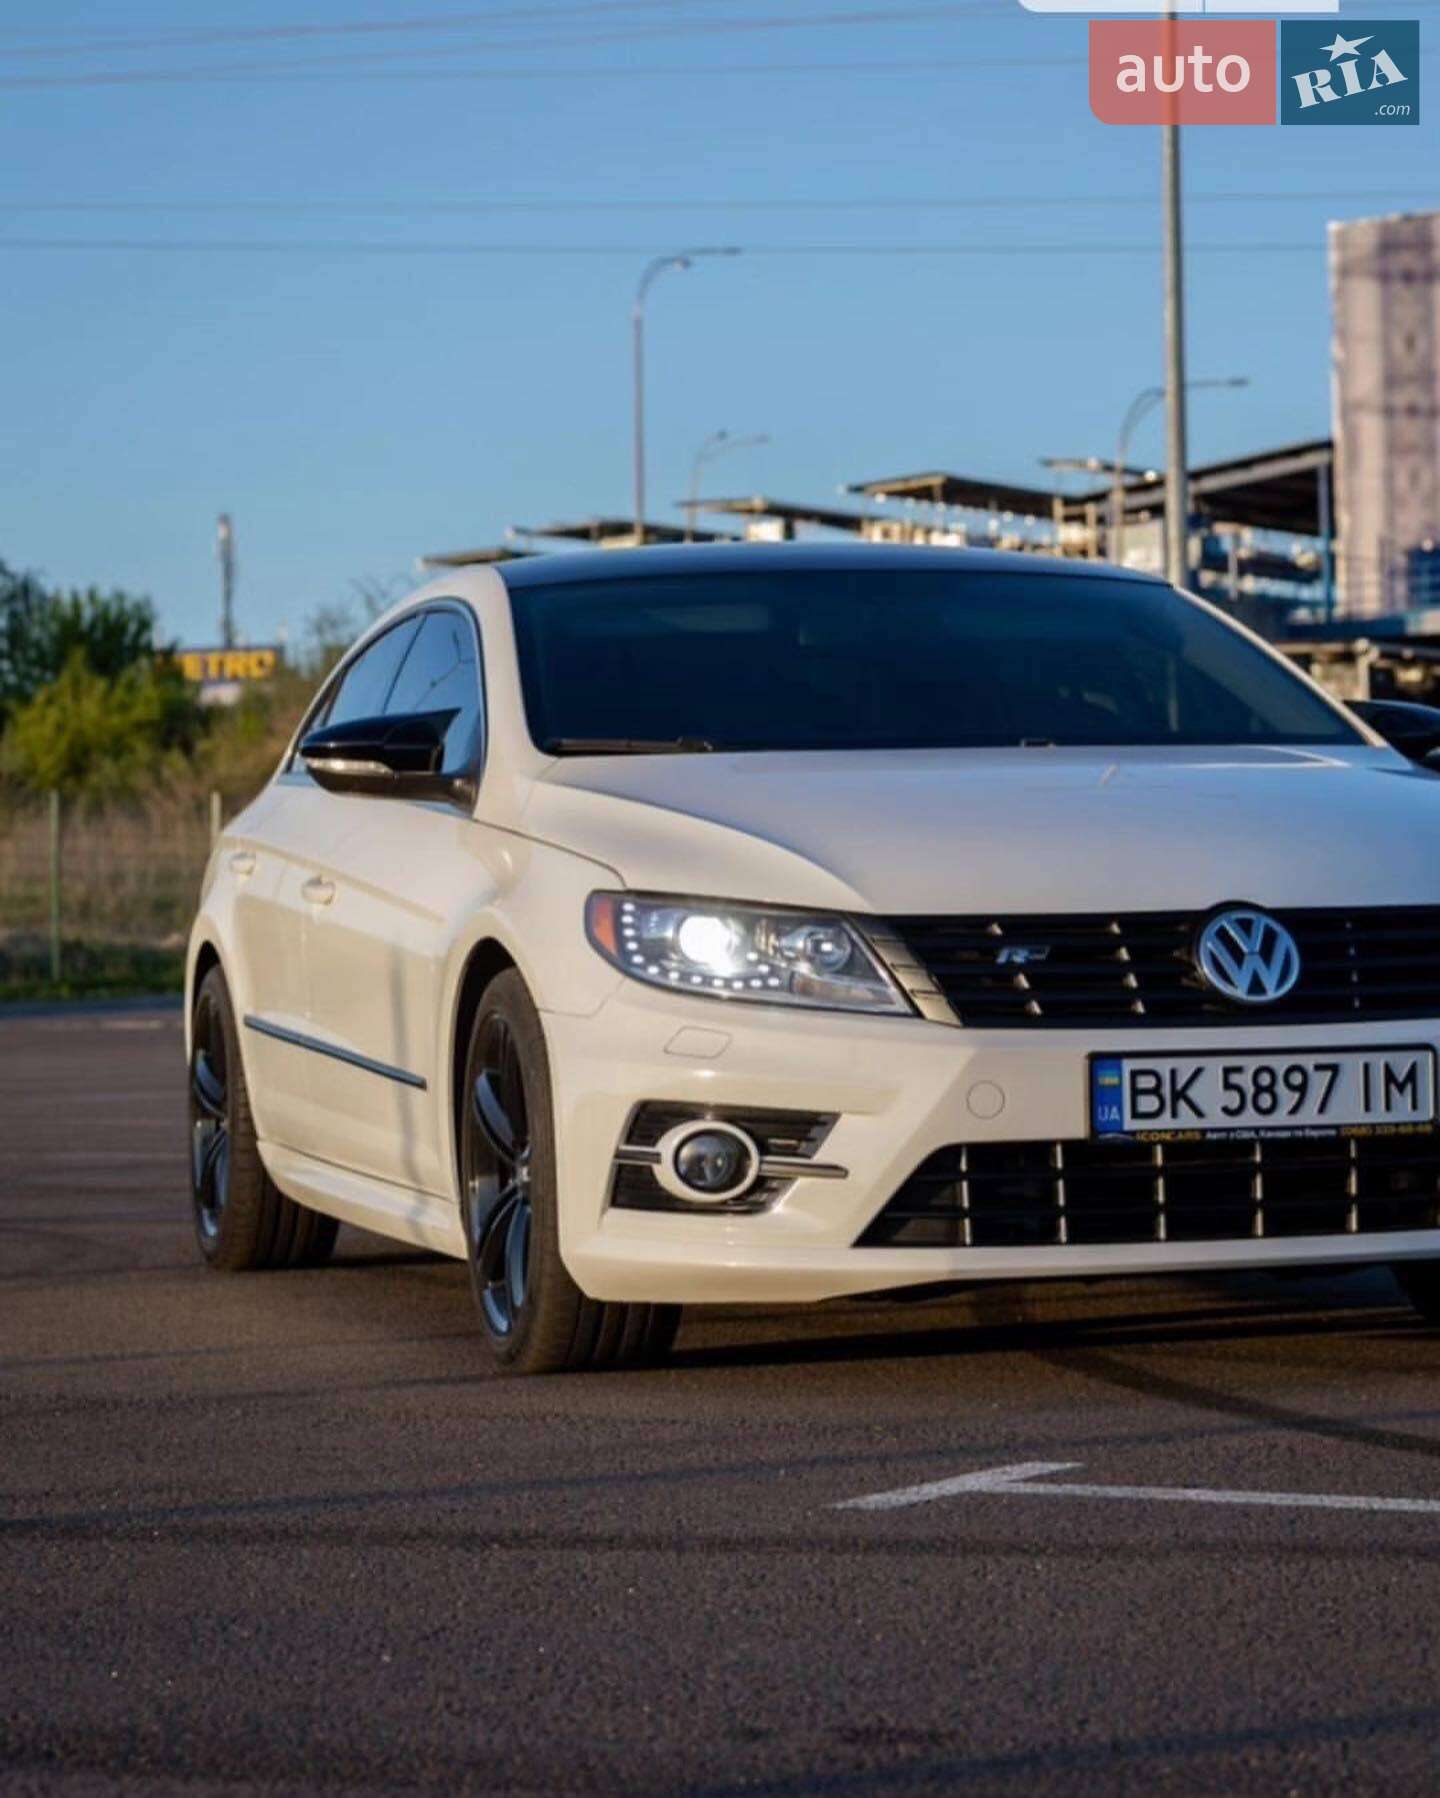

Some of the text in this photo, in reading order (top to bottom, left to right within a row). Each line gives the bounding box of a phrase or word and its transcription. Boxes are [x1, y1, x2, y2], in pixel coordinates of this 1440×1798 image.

[176, 650, 276, 681] ETRO
[1129, 1060, 1418, 1119] BK 5897 IM
[1098, 1105, 1121, 1121] UA
